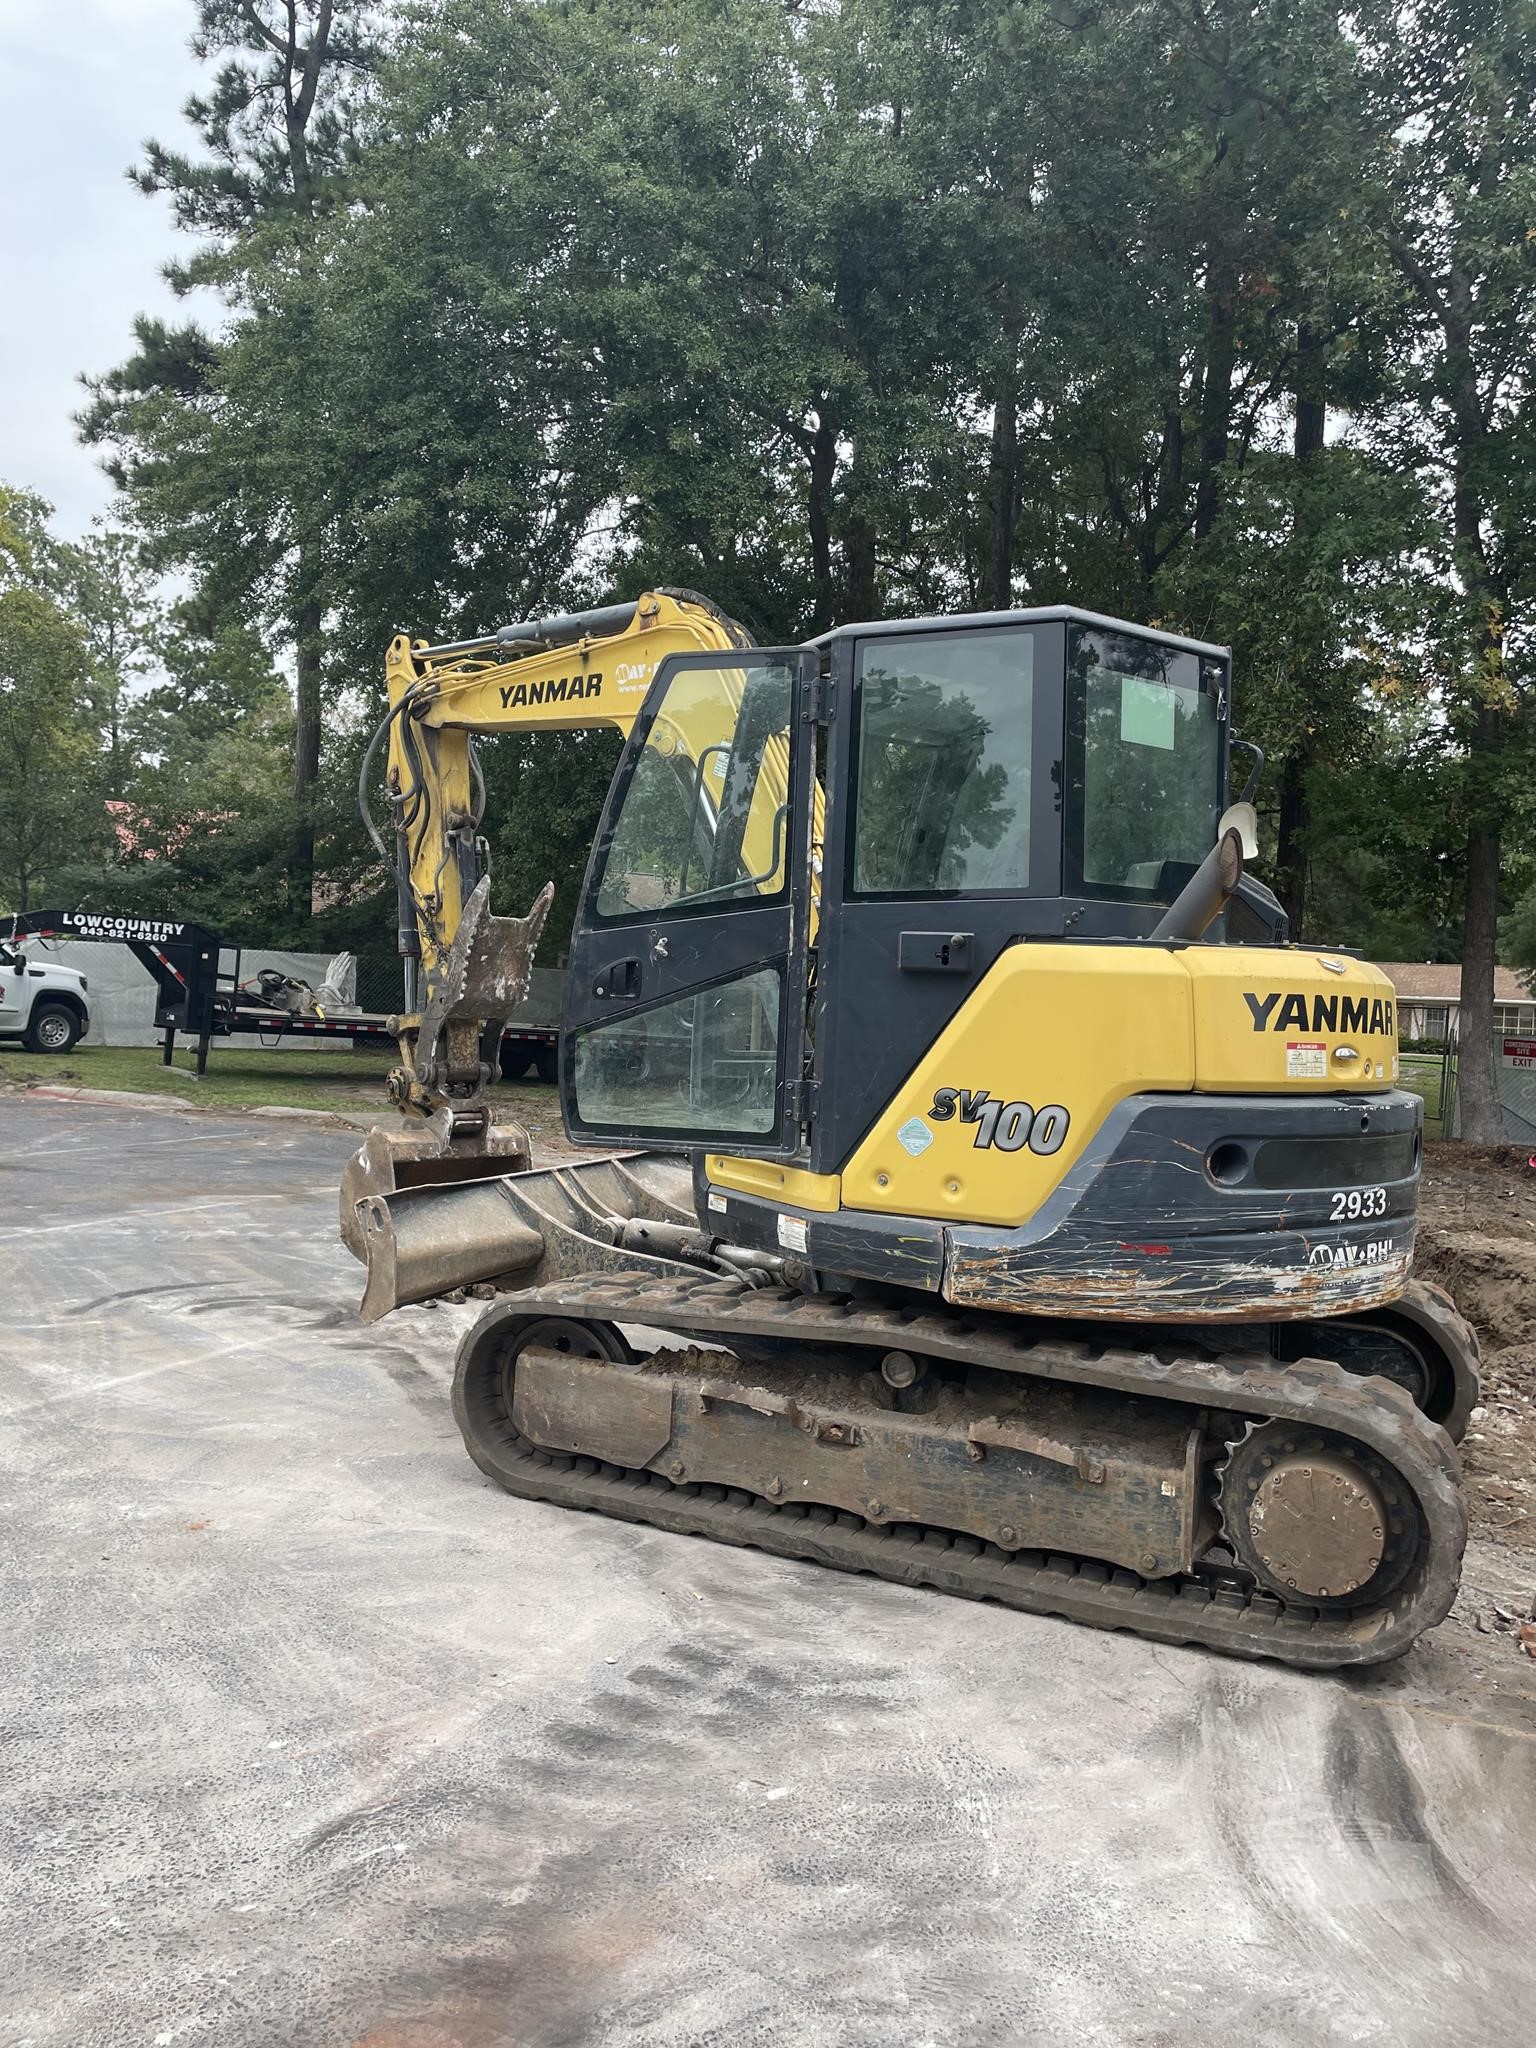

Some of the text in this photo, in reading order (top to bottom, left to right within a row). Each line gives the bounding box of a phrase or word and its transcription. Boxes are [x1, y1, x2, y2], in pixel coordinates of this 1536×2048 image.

[499, 673, 603, 709] YANMAR
[62, 912, 184, 935] LOWCOUNTRY
[80, 926, 168, 942] 843-821-6260
[1242, 992, 1393, 1036] YANMAR
[1512, 1057, 1533, 1068] EXIT
[1329, 1188, 1387, 1221] 2933
